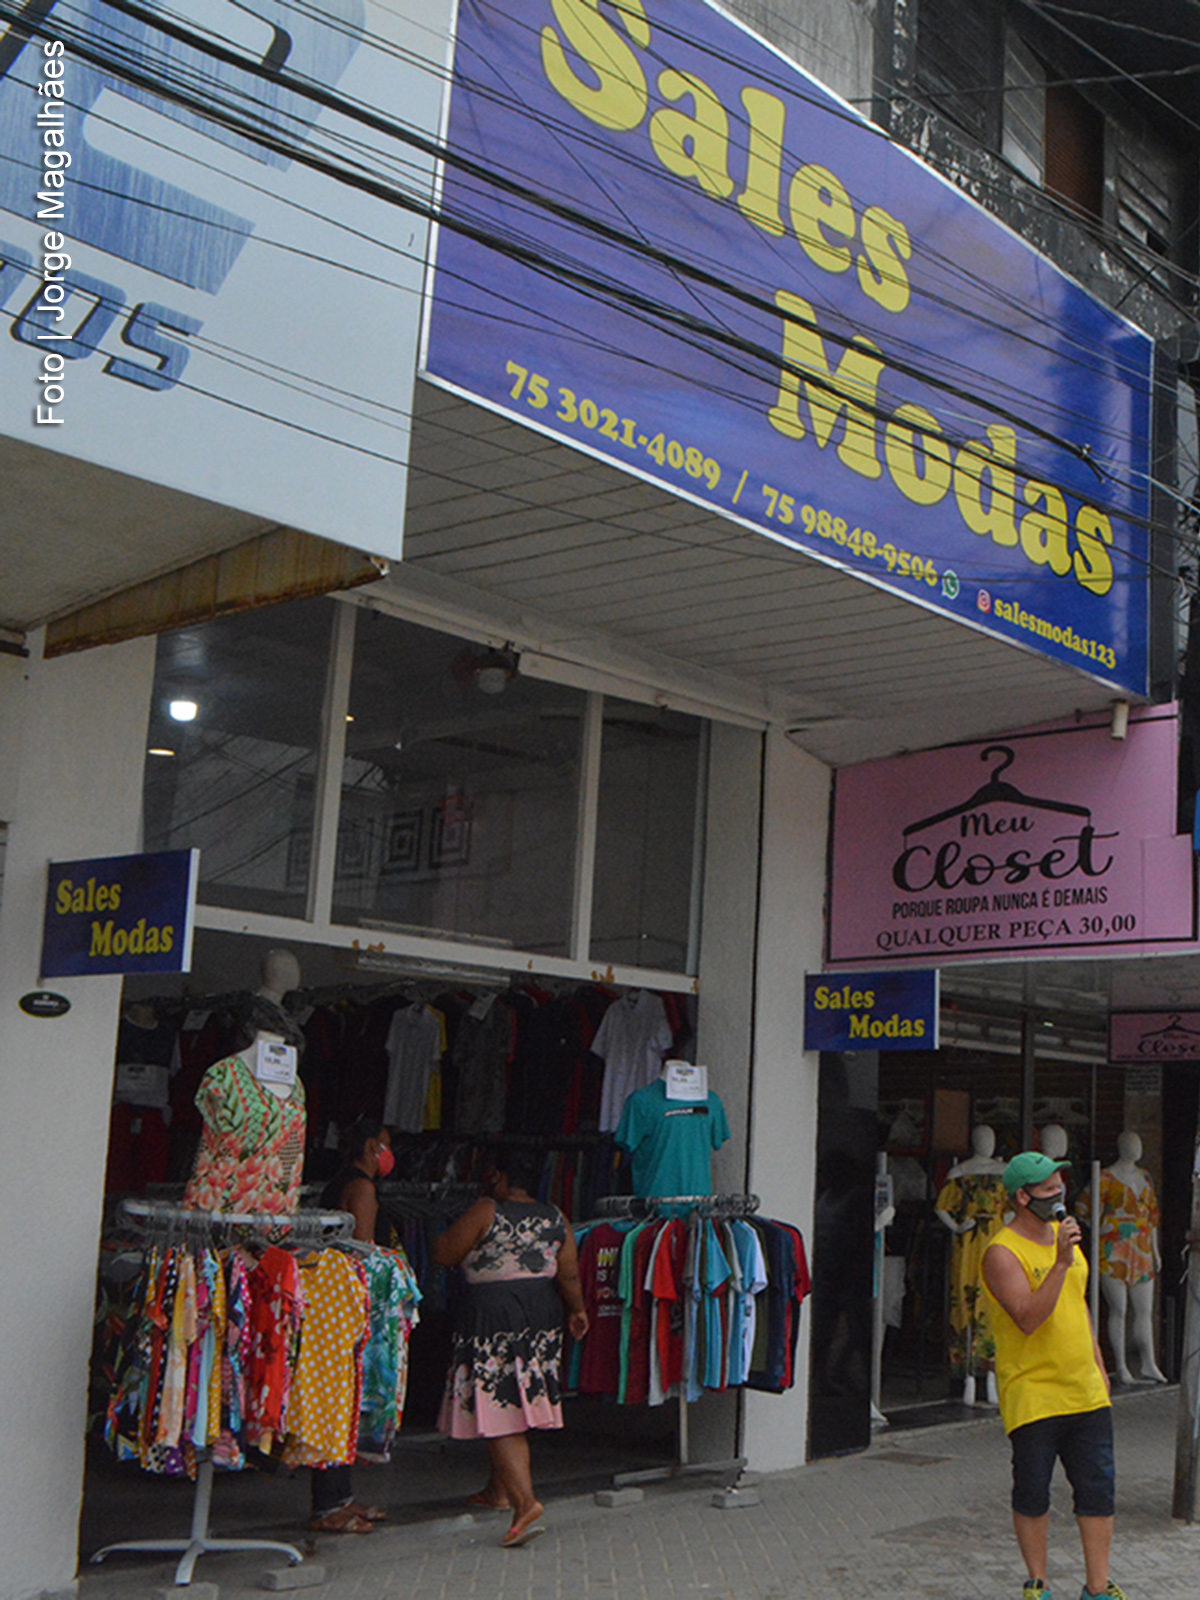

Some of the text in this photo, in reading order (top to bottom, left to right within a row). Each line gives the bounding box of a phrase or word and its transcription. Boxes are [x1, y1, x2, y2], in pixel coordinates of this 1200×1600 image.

[540, 0, 912, 313] Sales
[767, 289, 1115, 597] Modas
[505, 359, 550, 410] 75
[556, 387, 722, 491] 3021-4089
[762, 483, 796, 525] 75
[800, 504, 939, 587] 98848-9506
[994, 596, 1117, 670] salesmodas123
[960, 812, 1035, 838] Meu
[892, 825, 1120, 893] Closet
[55, 877, 122, 915] Sales
[892, 886, 1109, 920] PORQUE ROUPA NUNCA É DEMAIS
[88, 917, 174, 957] Modas
[876, 914, 1137, 951] QUALQUER PEÇA 30,00
[814, 985, 876, 1010] Sales
[848, 1013, 926, 1039] Modas
[1138, 1040, 1200, 1054] Close
